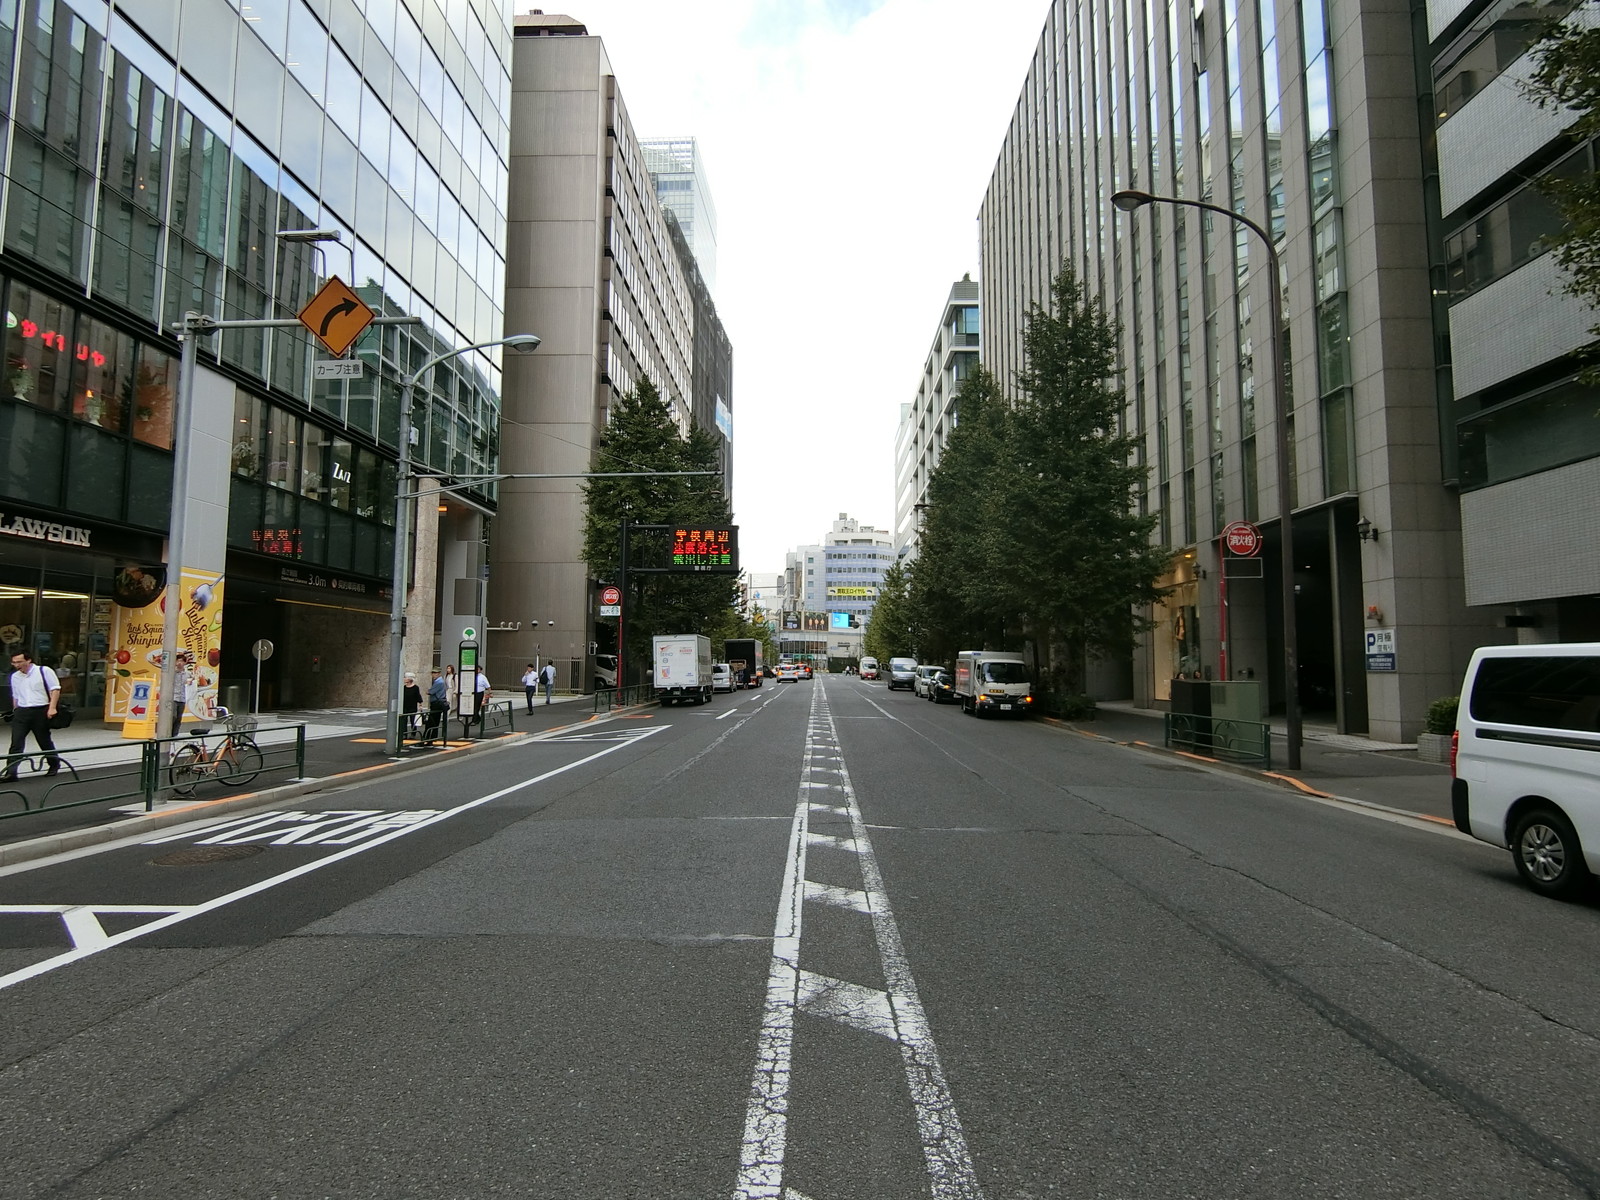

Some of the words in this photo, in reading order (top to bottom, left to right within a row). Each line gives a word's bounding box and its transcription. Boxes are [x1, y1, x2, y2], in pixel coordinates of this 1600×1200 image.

[317, 363, 361, 375] カーブ注意
[0, 512, 92, 548] LAWSON
[674, 529, 730, 542] 学校周辺
[1230, 535, 1253, 546] 消火栓
[308, 573, 327, 588] 3.0m
[127, 622, 142, 635] Link
[142, 622, 164, 637] Squa
[126, 633, 164, 648] Shinjuk
[1366, 632, 1376, 653] P
[1377, 632, 1392, 642] 月極
